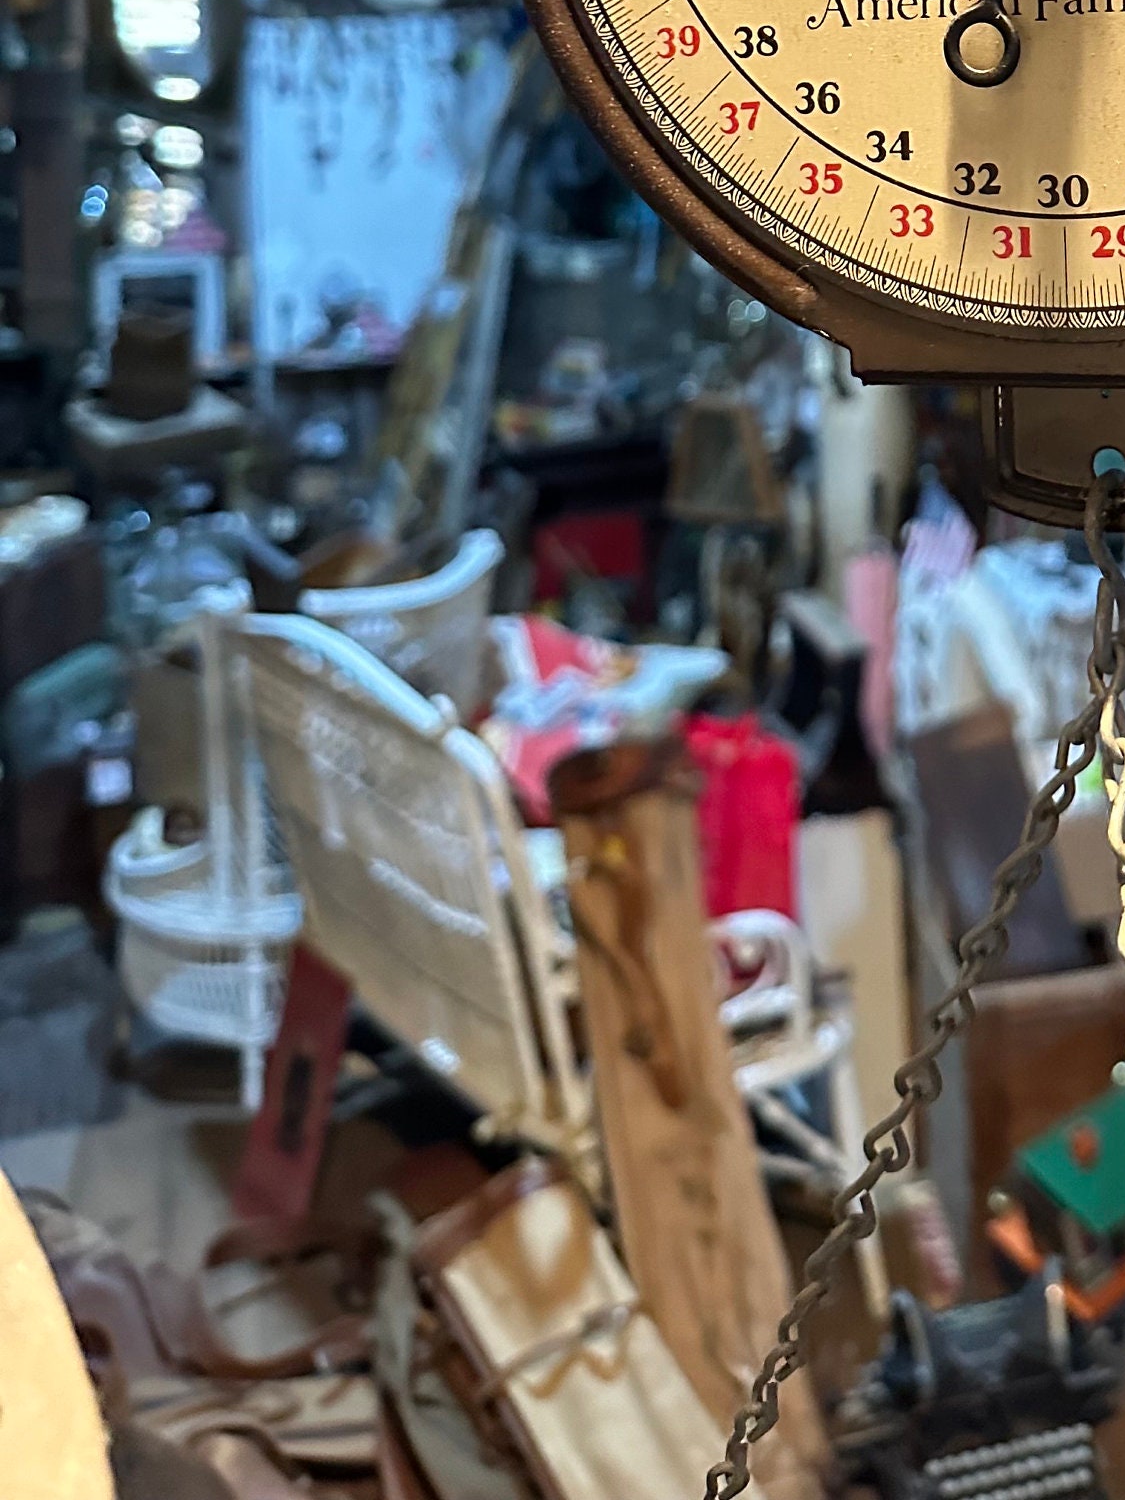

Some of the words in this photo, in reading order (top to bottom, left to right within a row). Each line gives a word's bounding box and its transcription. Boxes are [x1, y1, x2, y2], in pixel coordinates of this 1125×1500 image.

[658, 25, 700, 59] 39
[734, 26, 778, 58] 38
[795, 82, 840, 114] 36
[721, 101, 760, 135] 37
[866, 131, 913, 162] 34
[801, 163, 843, 195] 35
[954, 163, 1001, 195] 32
[1038, 175, 1088, 208] 30
[891, 204, 934, 238] 33
[995, 225, 1031, 259] 31
